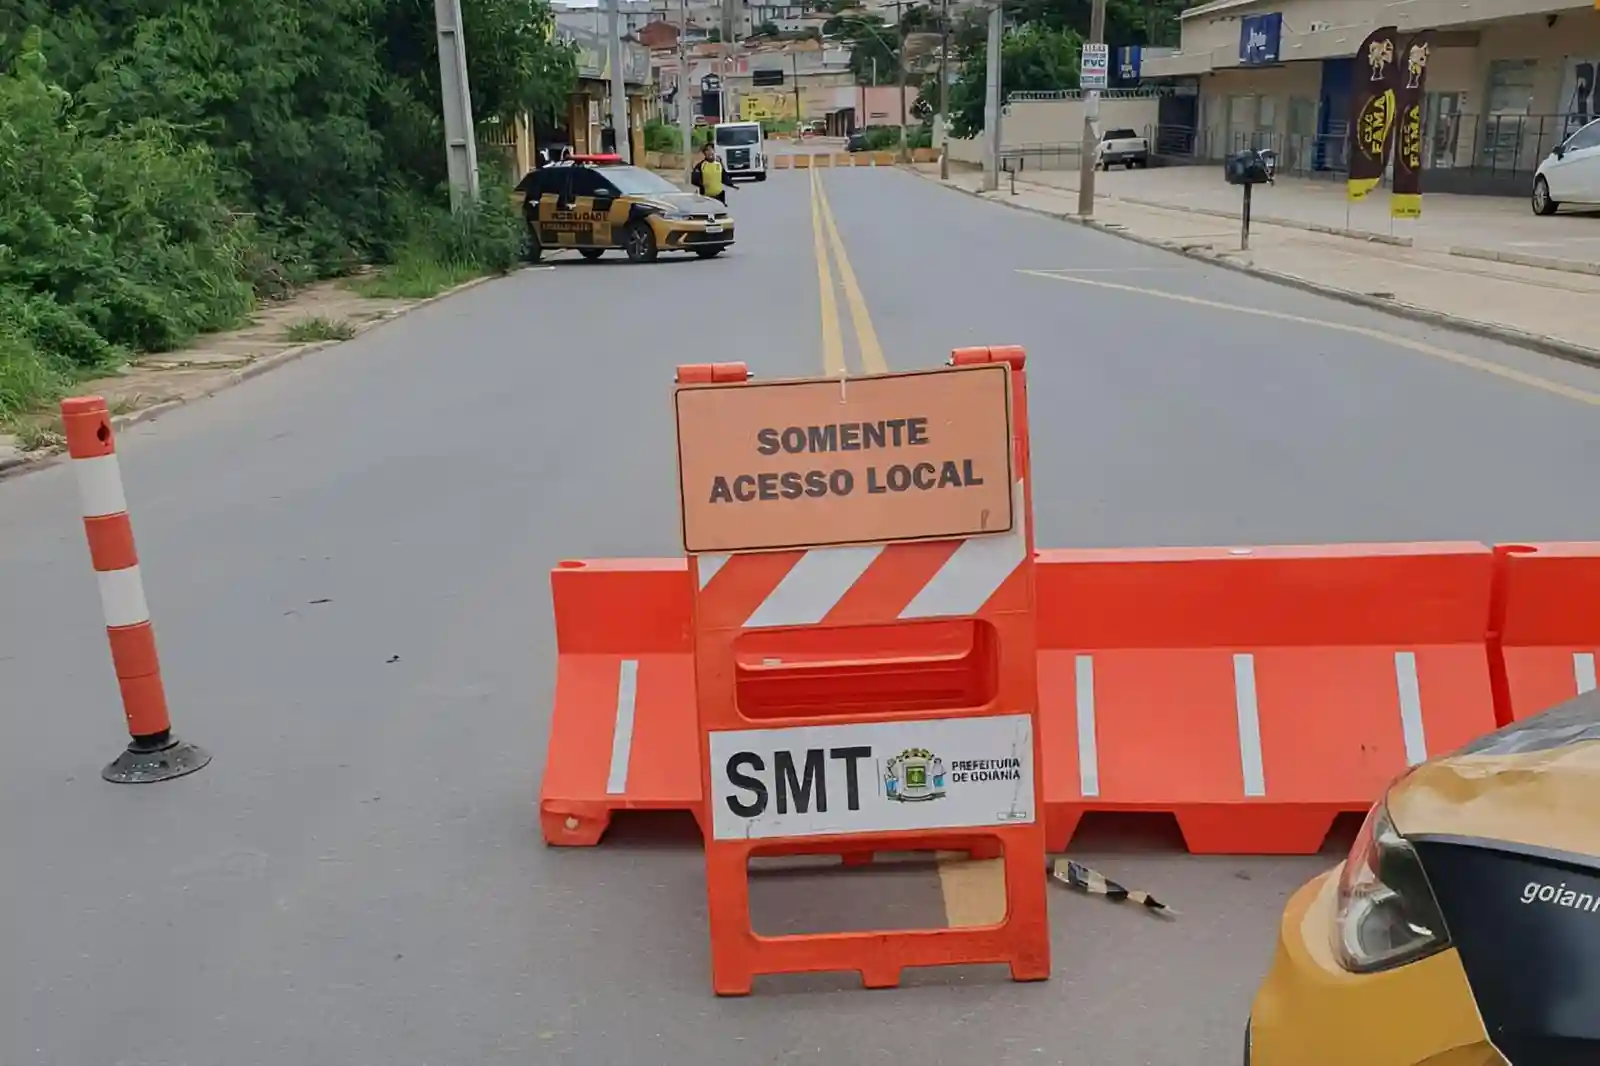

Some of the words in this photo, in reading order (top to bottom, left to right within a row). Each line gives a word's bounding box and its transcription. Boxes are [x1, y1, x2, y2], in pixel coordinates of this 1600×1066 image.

[1083, 59, 1105, 68] PVC
[1372, 95, 1387, 155] FAMA
[1410, 104, 1421, 168] FAMA
[757, 417, 929, 456] SOMENTE
[709, 468, 854, 503] ACESSO
[866, 459, 983, 494] LOCAL
[725, 745, 872, 818] SMT
[951, 758, 1020, 771] PREFEITURA
[952, 772, 969, 782] DE
